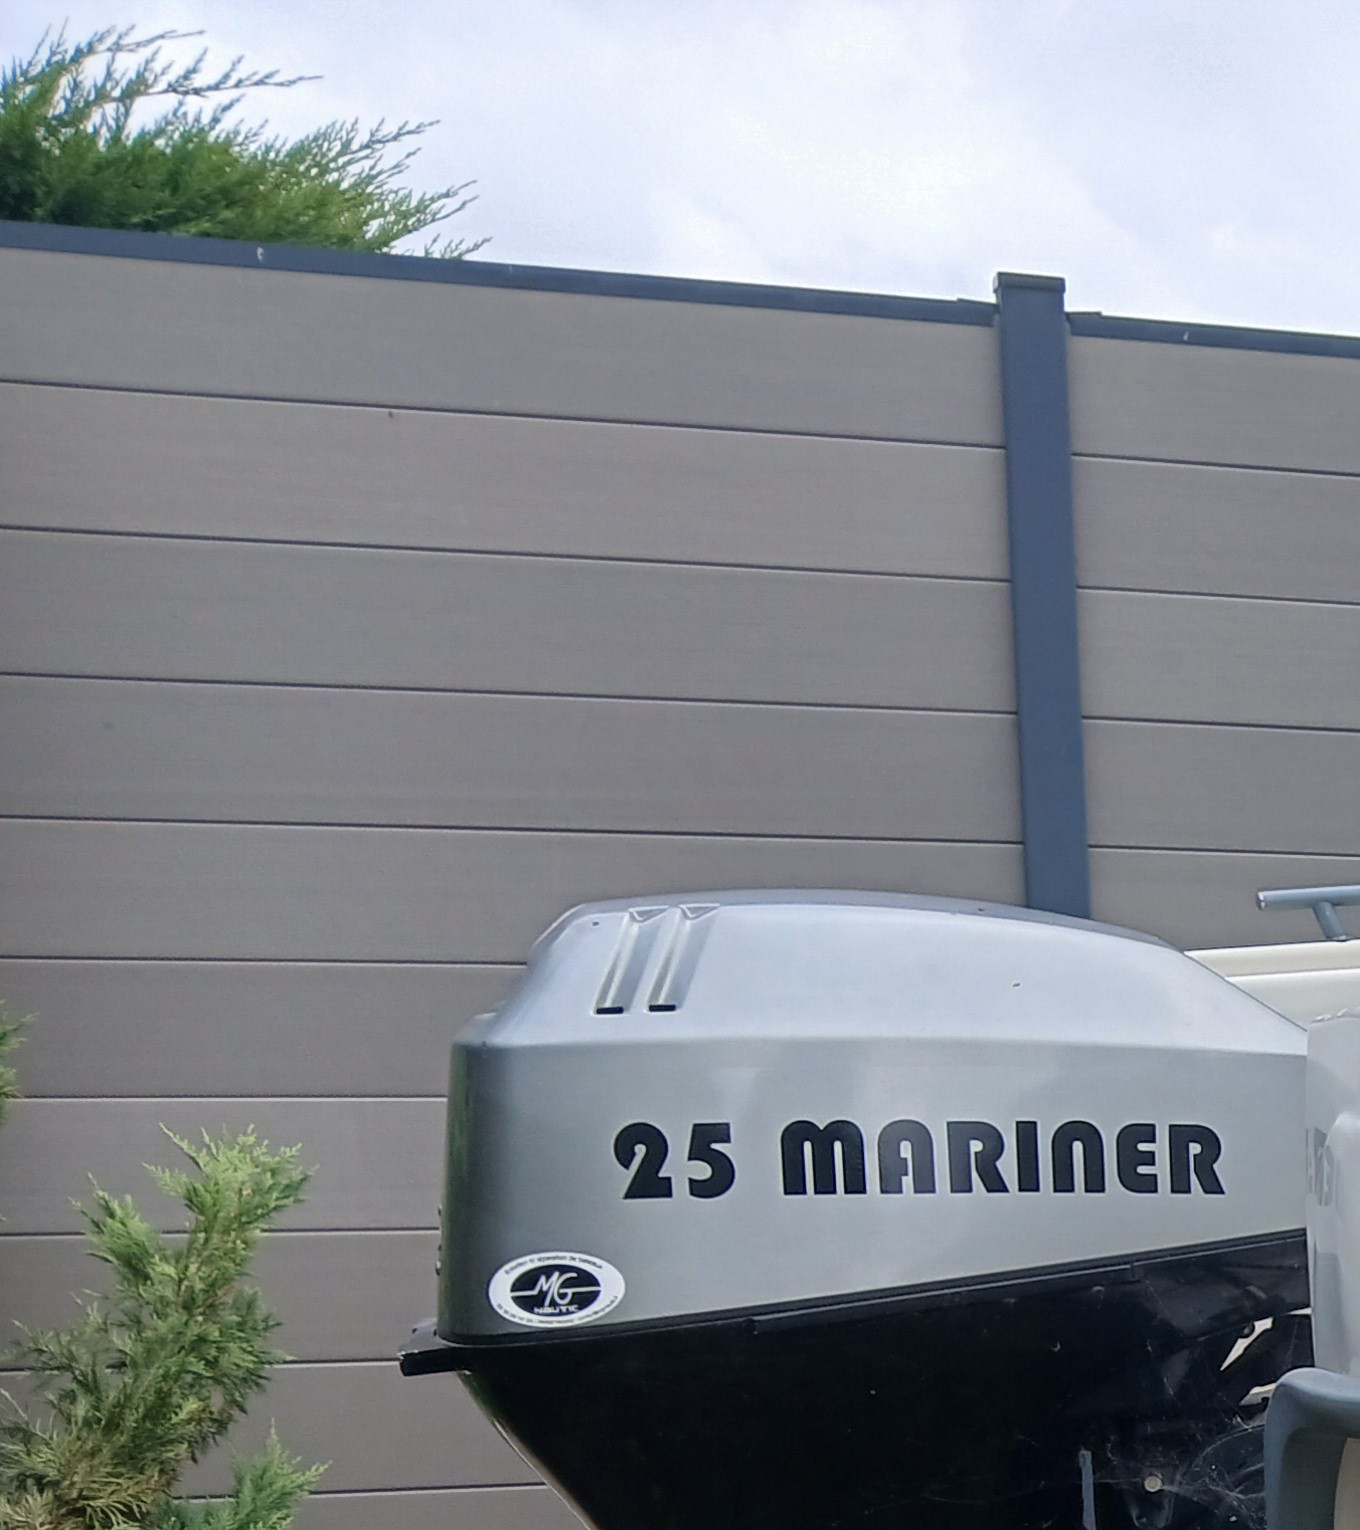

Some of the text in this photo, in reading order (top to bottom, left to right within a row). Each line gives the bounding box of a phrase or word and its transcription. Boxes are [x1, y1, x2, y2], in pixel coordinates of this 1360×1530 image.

[612, 1121, 736, 1199] 25
[780, 1119, 1226, 1196] MARINER
[533, 1270, 579, 1307] MG
